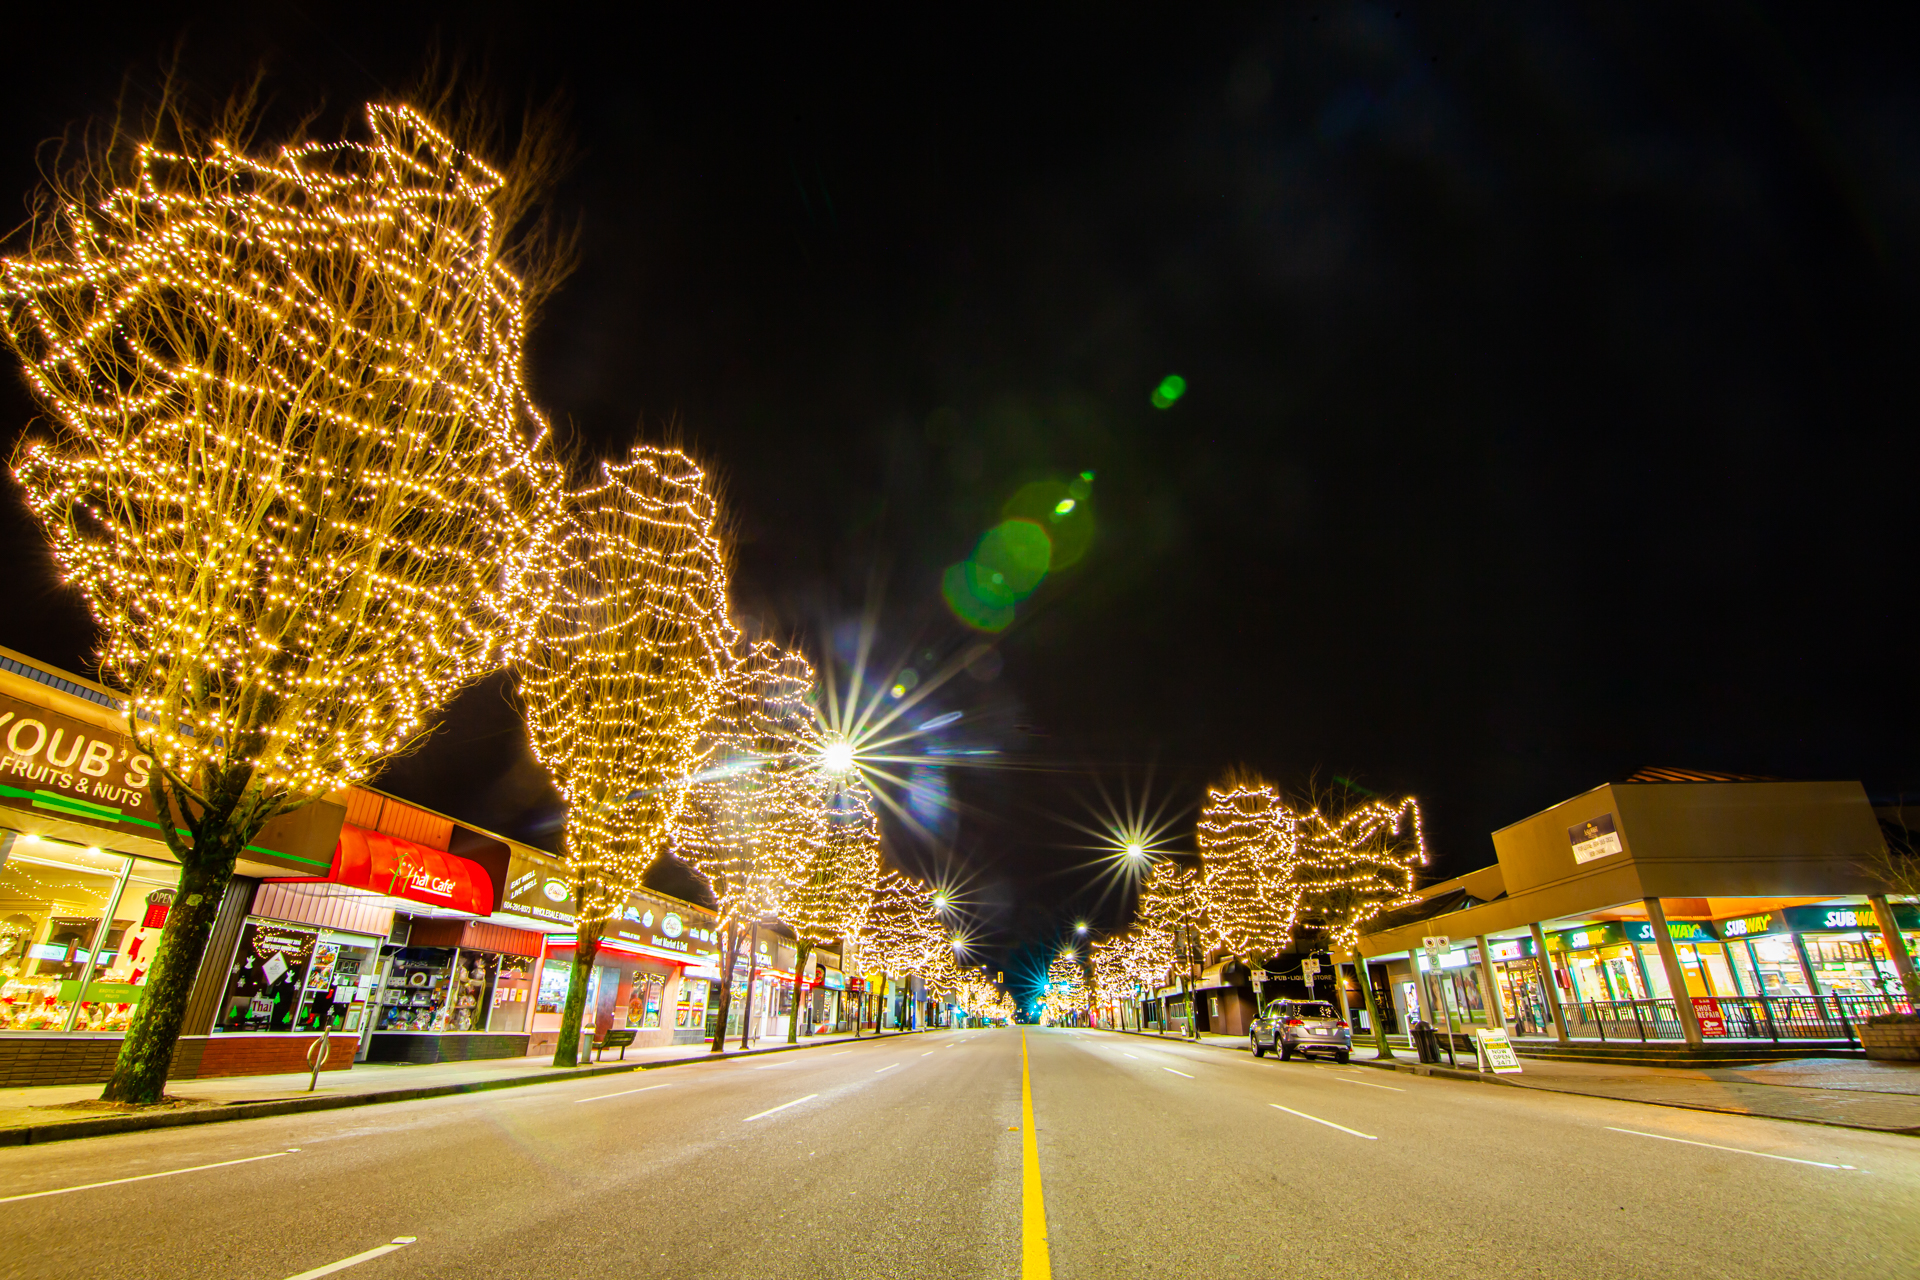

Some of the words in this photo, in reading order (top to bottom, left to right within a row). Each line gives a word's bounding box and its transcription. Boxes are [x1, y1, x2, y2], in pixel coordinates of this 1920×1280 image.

[0, 755, 73, 789] FRUITS
[75, 777, 89, 794] &
[92, 781, 143, 807] NUTS
[510, 877, 521, 890] EAT
[521, 869, 536, 883] WELL
[510, 886, 523, 899] LIVE
[523, 878, 538, 892] WELL
[151, 891, 176, 904] OPEN
[532, 905, 559, 920] WHOLESALE
[1823, 911, 1880, 928] SUBWA
[1638, 923, 1701, 939] SWAY
[1724, 914, 1772, 938] SUBWAY
[651, 935, 663, 947] Meat
[662, 937, 676, 949] Market
[680, 941, 689, 952] Deli
[1572, 927, 1607, 949] SUBWAY
[252, 1000, 273, 1012] Thai
[1694, 1004, 1712, 1012] SHOE
[1696, 1011, 1720, 1019] REPAIR
